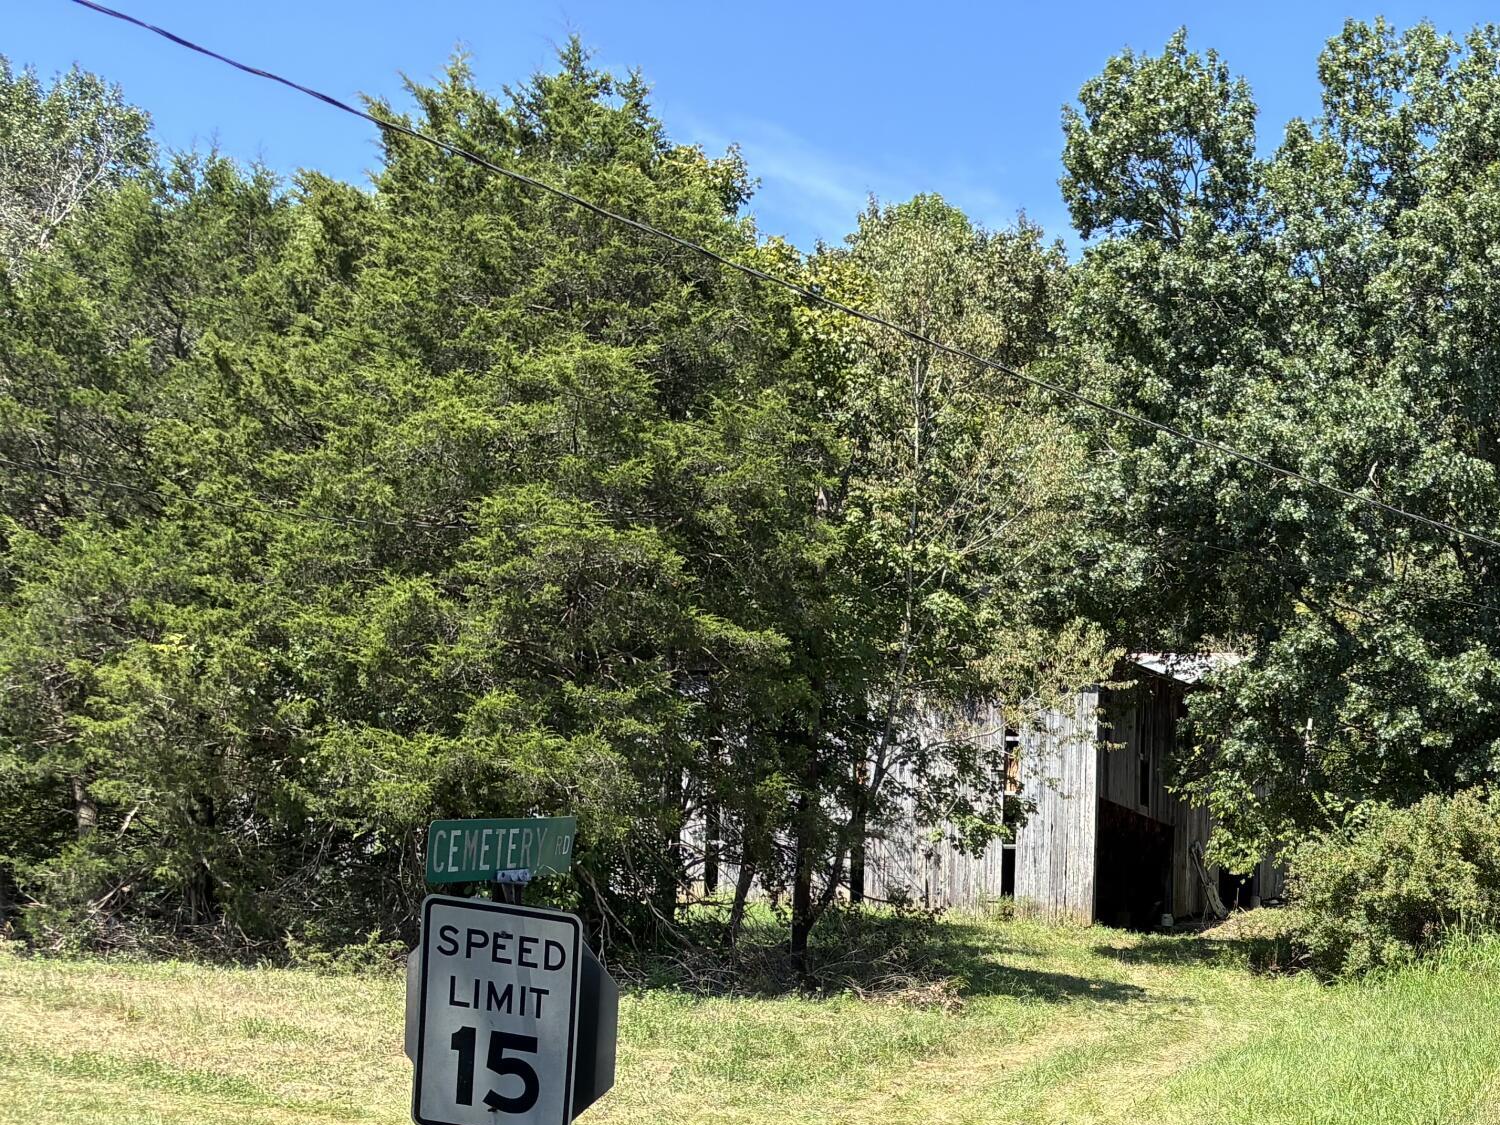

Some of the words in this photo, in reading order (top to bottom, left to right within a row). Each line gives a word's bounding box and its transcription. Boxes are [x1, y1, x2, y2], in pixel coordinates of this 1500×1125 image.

[433, 827, 548, 873] CEMETERY
[554, 835, 571, 856] RD
[437, 925, 567, 971] SPEED
[449, 976, 550, 1019] LIMIT
[450, 1026, 540, 1115] 15
